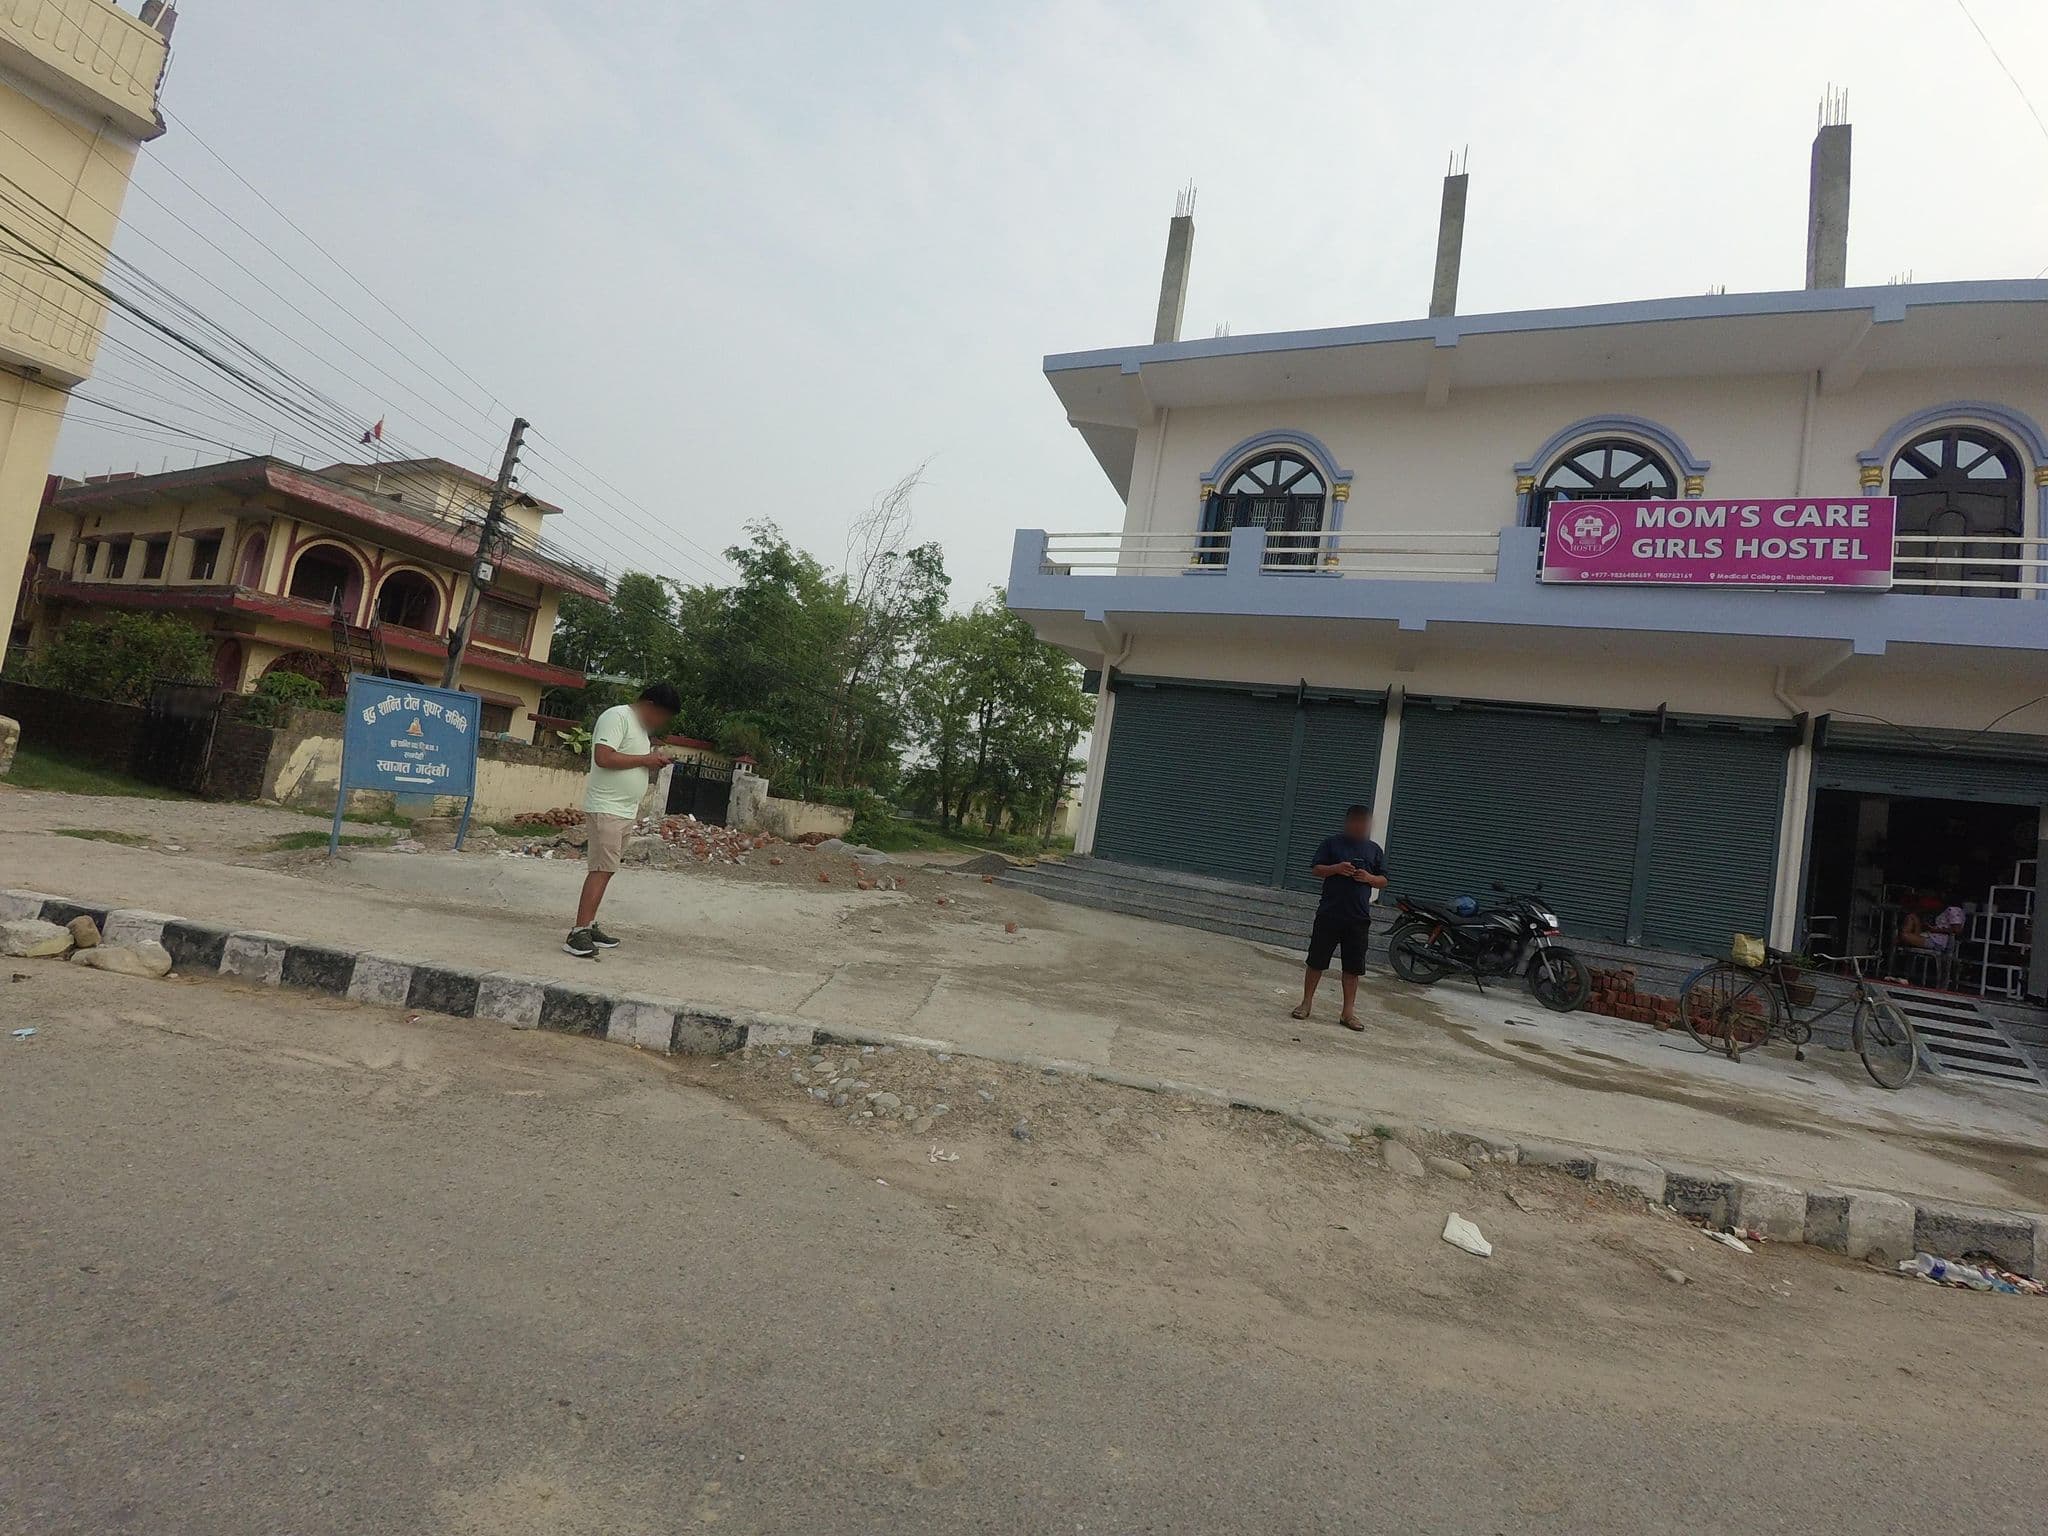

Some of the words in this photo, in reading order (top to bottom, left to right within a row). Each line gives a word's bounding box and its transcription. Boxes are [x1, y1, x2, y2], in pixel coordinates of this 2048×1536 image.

[1773, 504, 1869, 528] CARE
[1632, 538, 1723, 560] GIRLS
[1735, 538, 1868, 561] HOSTEL
[404, 693, 420, 711] टोल
[445, 710, 467, 733] समिति
[376, 759, 411, 774] स्वागत
